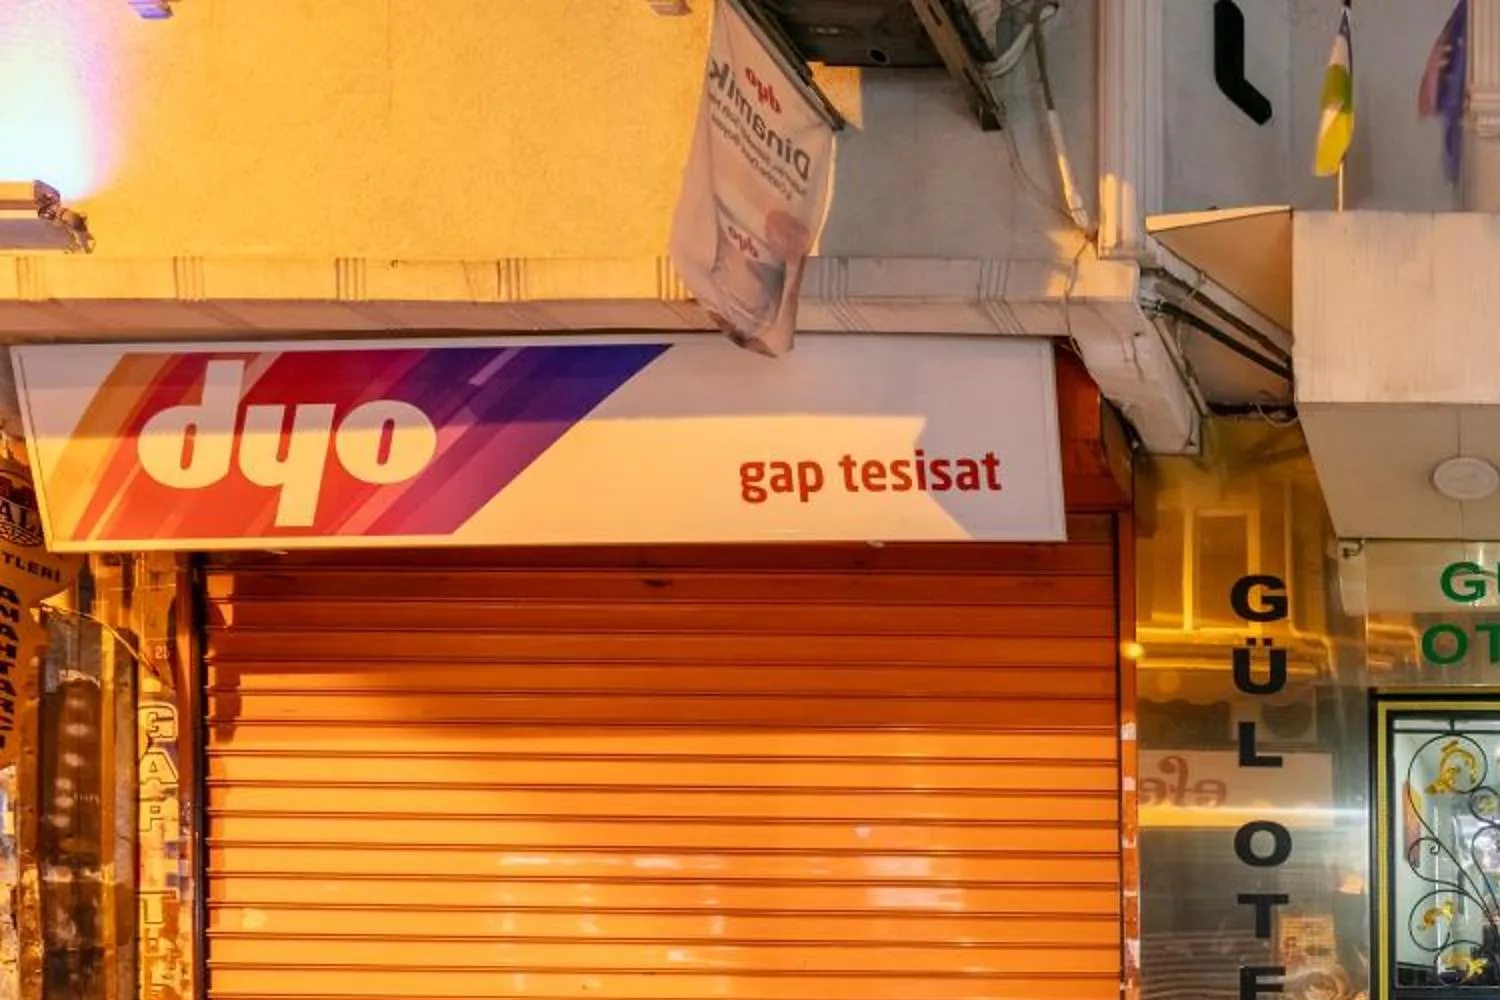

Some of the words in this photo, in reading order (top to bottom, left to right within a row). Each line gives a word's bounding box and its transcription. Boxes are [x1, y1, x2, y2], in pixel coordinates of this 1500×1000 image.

[137, 359, 437, 527] dyo
[739, 460, 824, 504] gap
[838, 449, 1002, 492] tesisat
[1230, 575, 1289, 768] GÜL
